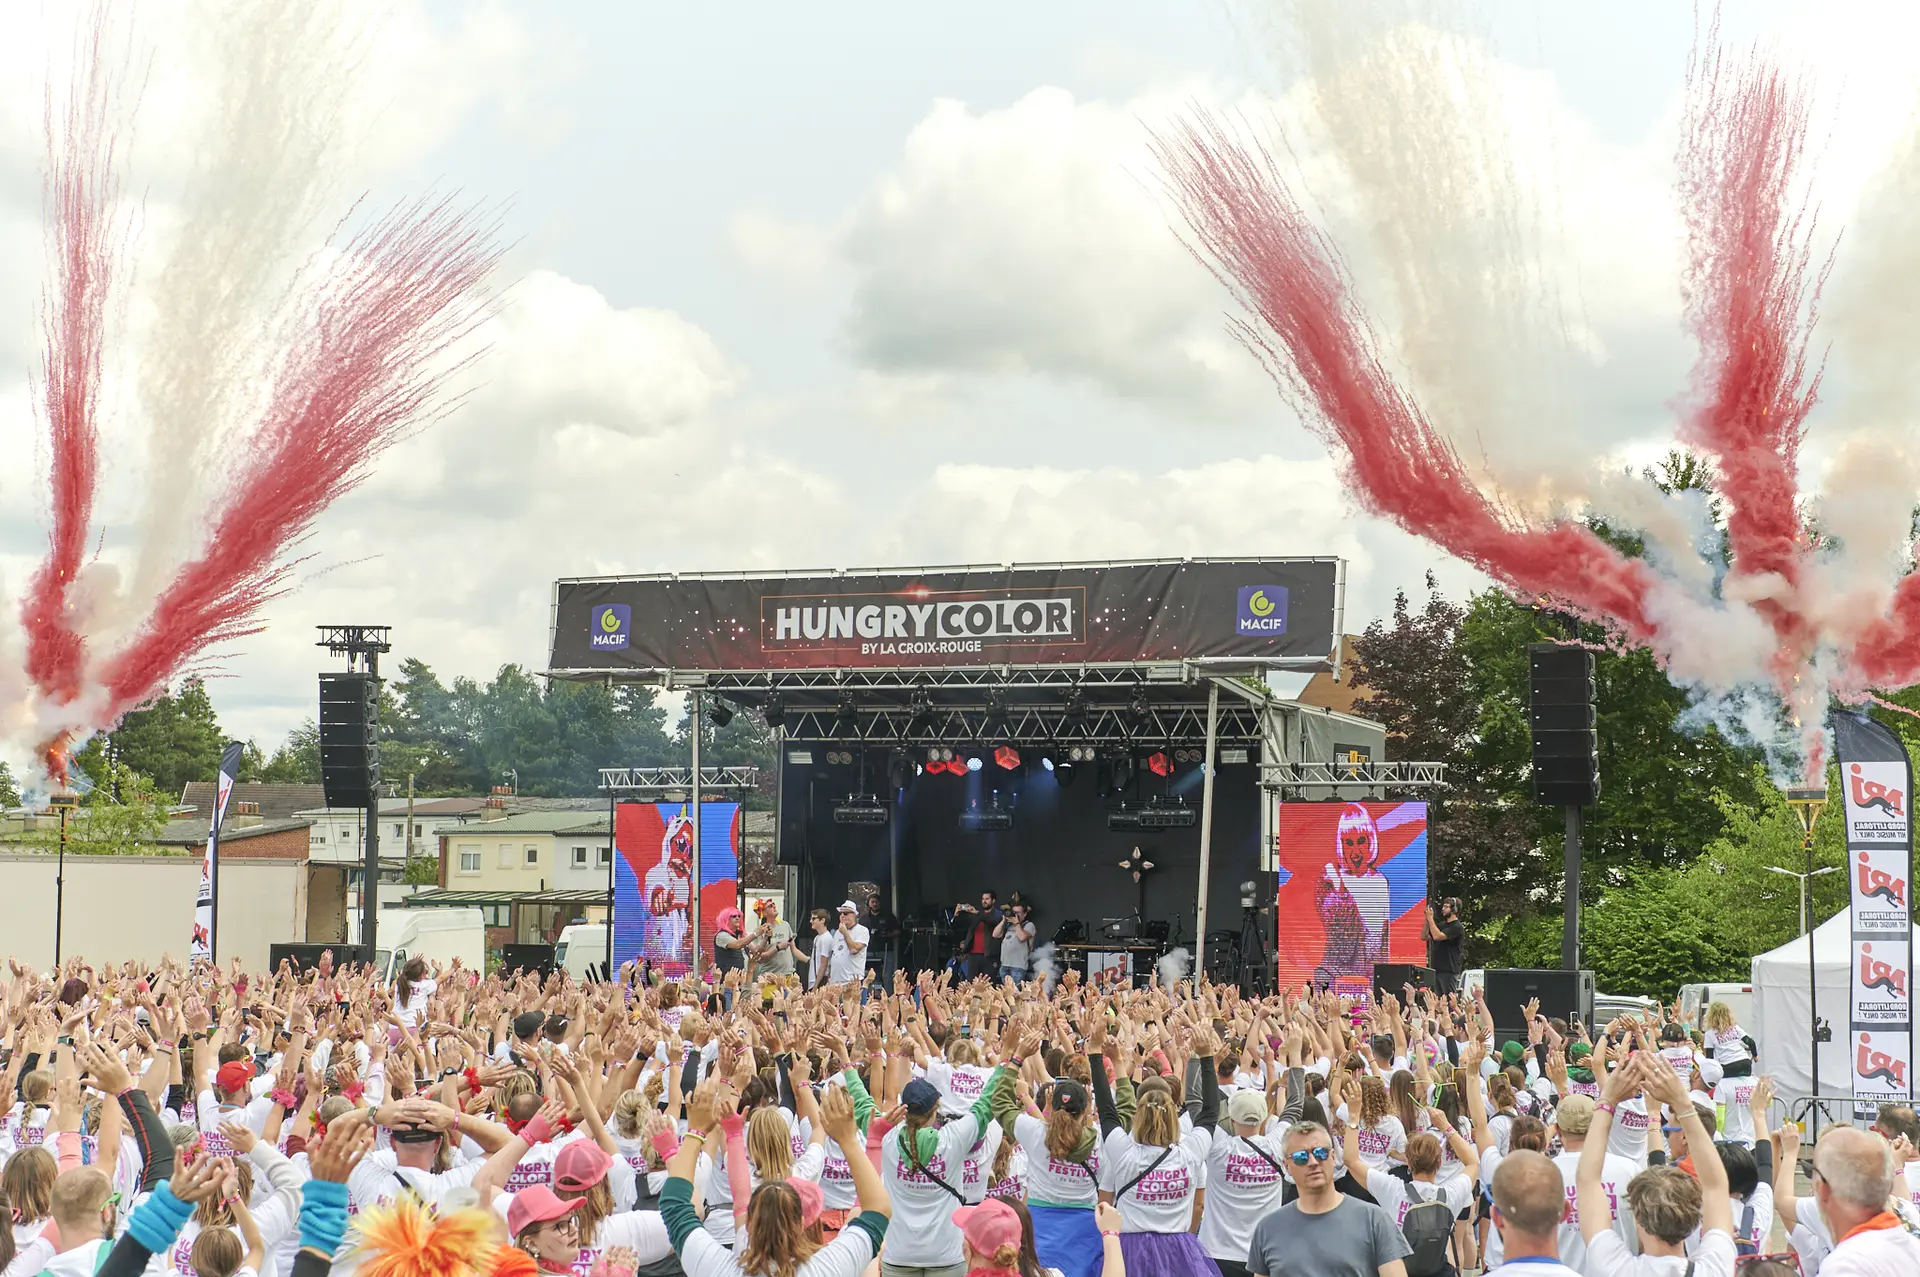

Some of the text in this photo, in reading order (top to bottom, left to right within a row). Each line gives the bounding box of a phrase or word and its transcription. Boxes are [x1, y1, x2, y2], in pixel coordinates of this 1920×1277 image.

[776, 602, 1069, 640] HUNGRY COLOR
[1240, 618, 1282, 630] MACIF
[593, 634, 626, 645] MACIF
[862, 640, 982, 654] BY LA CROIX-ROUGE
[515, 1162, 550, 1172] NGRY
[1231, 1166, 1273, 1175] COLOR
[510, 1174, 547, 1183] OLOR
[1142, 1180, 1185, 1192] COLOR
[1136, 1190, 1187, 1201] FESTIVAL
